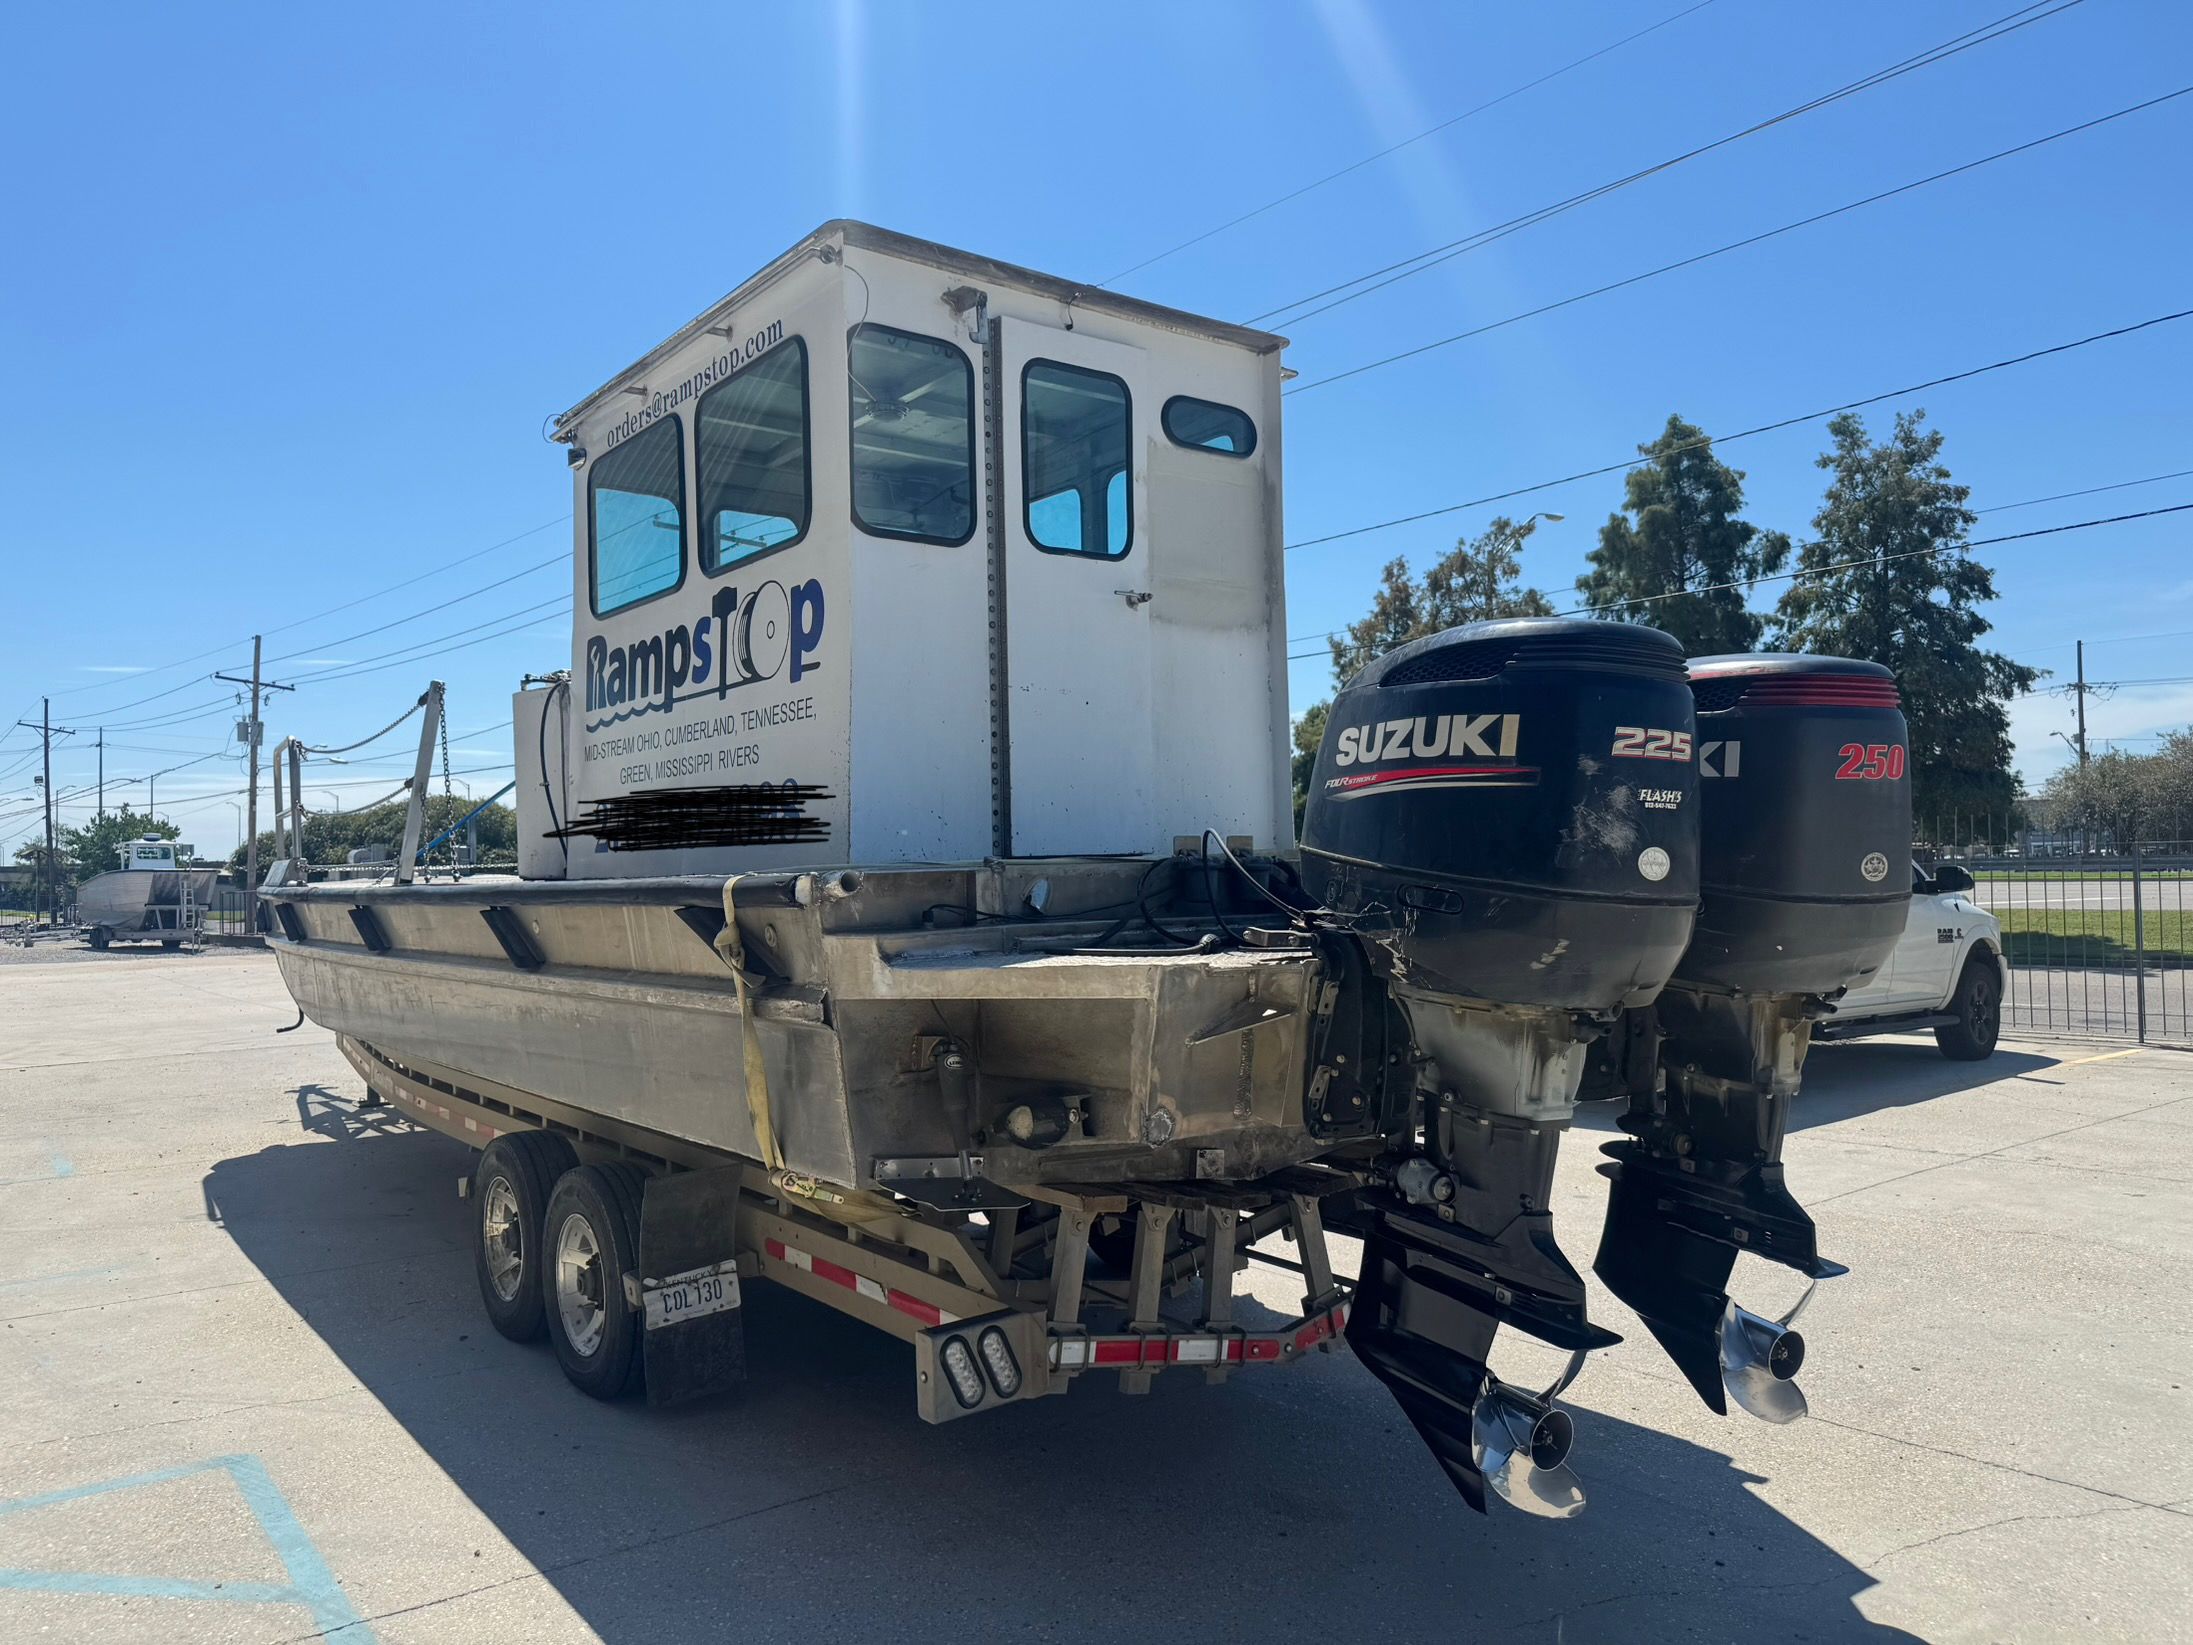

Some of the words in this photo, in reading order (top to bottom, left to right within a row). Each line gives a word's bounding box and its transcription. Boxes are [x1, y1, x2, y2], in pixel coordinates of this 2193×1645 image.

[607, 319, 784, 448] orders@rampstop.com
[584, 736, 635, 762] MID-STREAM
[637, 731, 663, 753] OHIO,
[664, 715, 738, 747] CUMBERLAND,
[741, 697, 817, 731] TENNESSEE,
[1336, 714, 1521, 767] SUZUKI
[1611, 726, 1692, 762] 225
[620, 764, 653, 785] GREEN,
[655, 753, 713, 780] MISSISSIPPI
[718, 744, 760, 770] RIVERS
[1835, 743, 1905, 780] 250
[1639, 788, 1682, 803] FLASH'S
